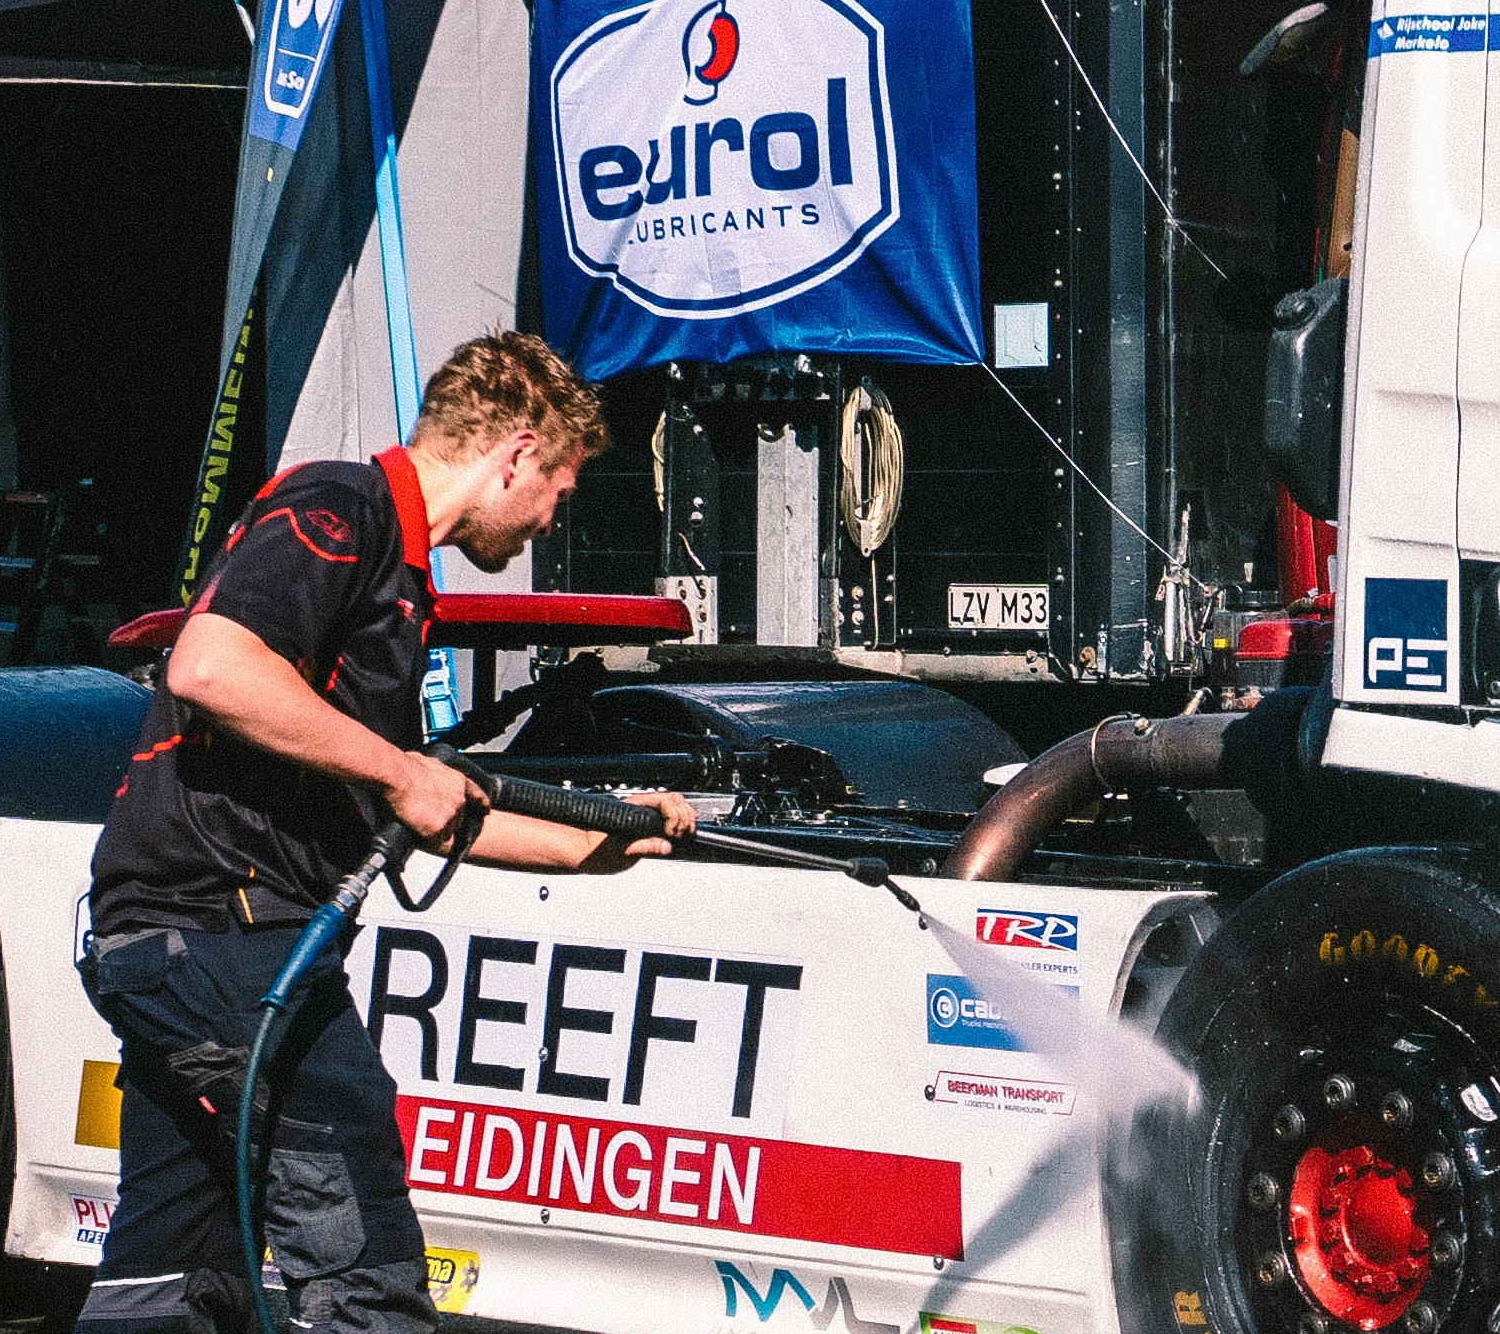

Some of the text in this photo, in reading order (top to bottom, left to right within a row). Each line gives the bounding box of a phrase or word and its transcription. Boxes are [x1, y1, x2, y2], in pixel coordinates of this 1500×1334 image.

[1456, 17, 1487, 32] Joke
[577, 75, 856, 223] eurol
[626, 201, 821, 247] UBRICANTS
[949, 584, 1049, 624] LZV M33
[978, 911, 1078, 951] TRP
[357, 924, 804, 1120] REEFT
[946, 1079, 1066, 1105] BEEKMAN TRANSPORT
[408, 1104, 761, 1227] EIDINGEN
[77, 1228, 108, 1245] APE
